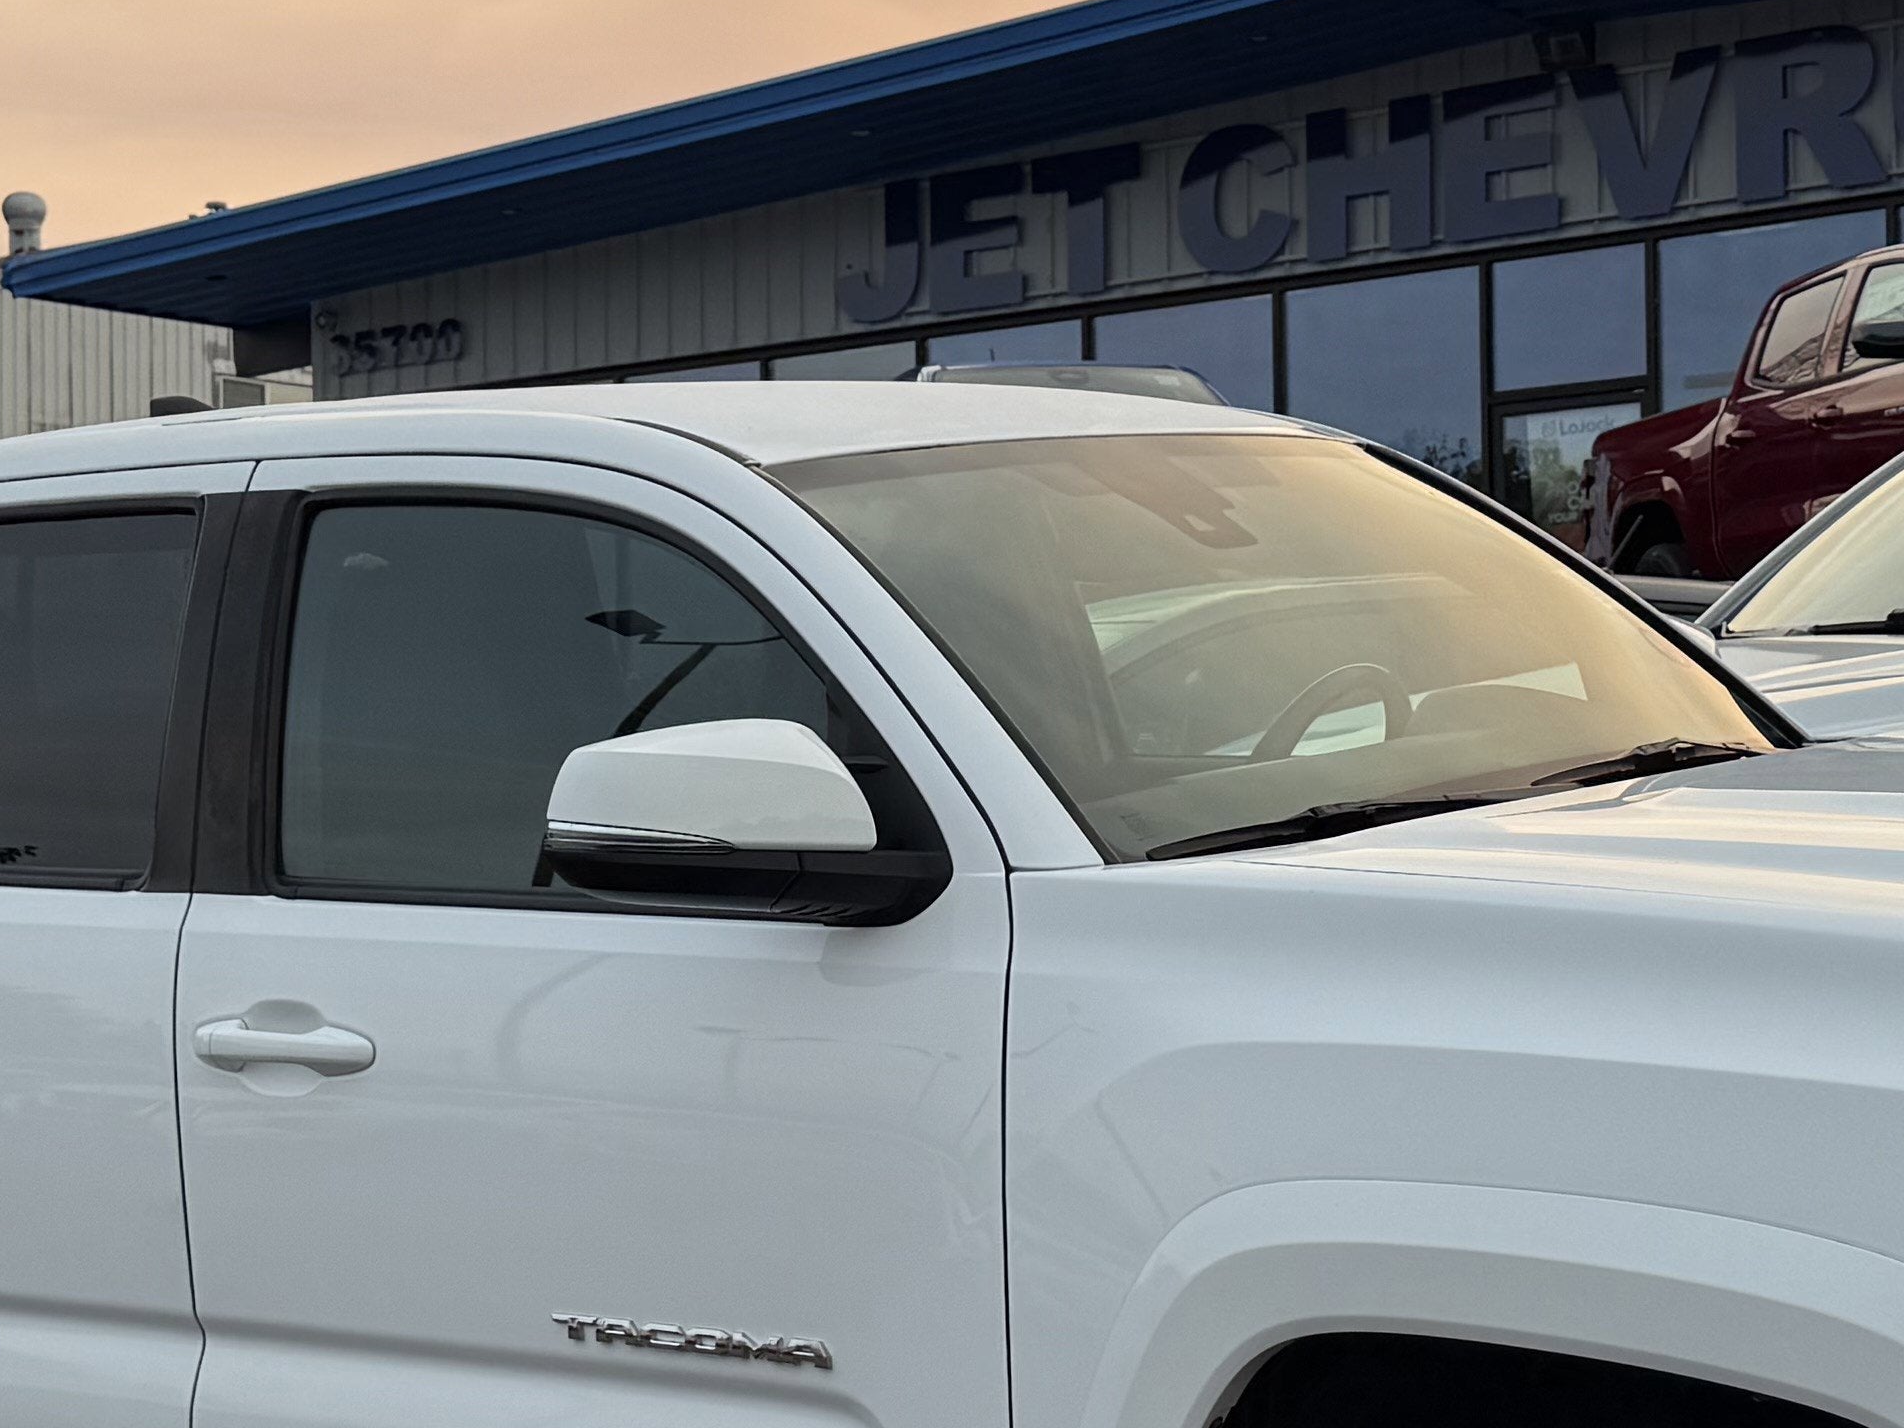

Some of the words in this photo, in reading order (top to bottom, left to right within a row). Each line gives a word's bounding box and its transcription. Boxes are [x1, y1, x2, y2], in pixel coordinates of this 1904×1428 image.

[836, 141, 1142, 324] JET
[330, 318, 463, 373] 35700
[550, 1312, 833, 1370] TACOMA
